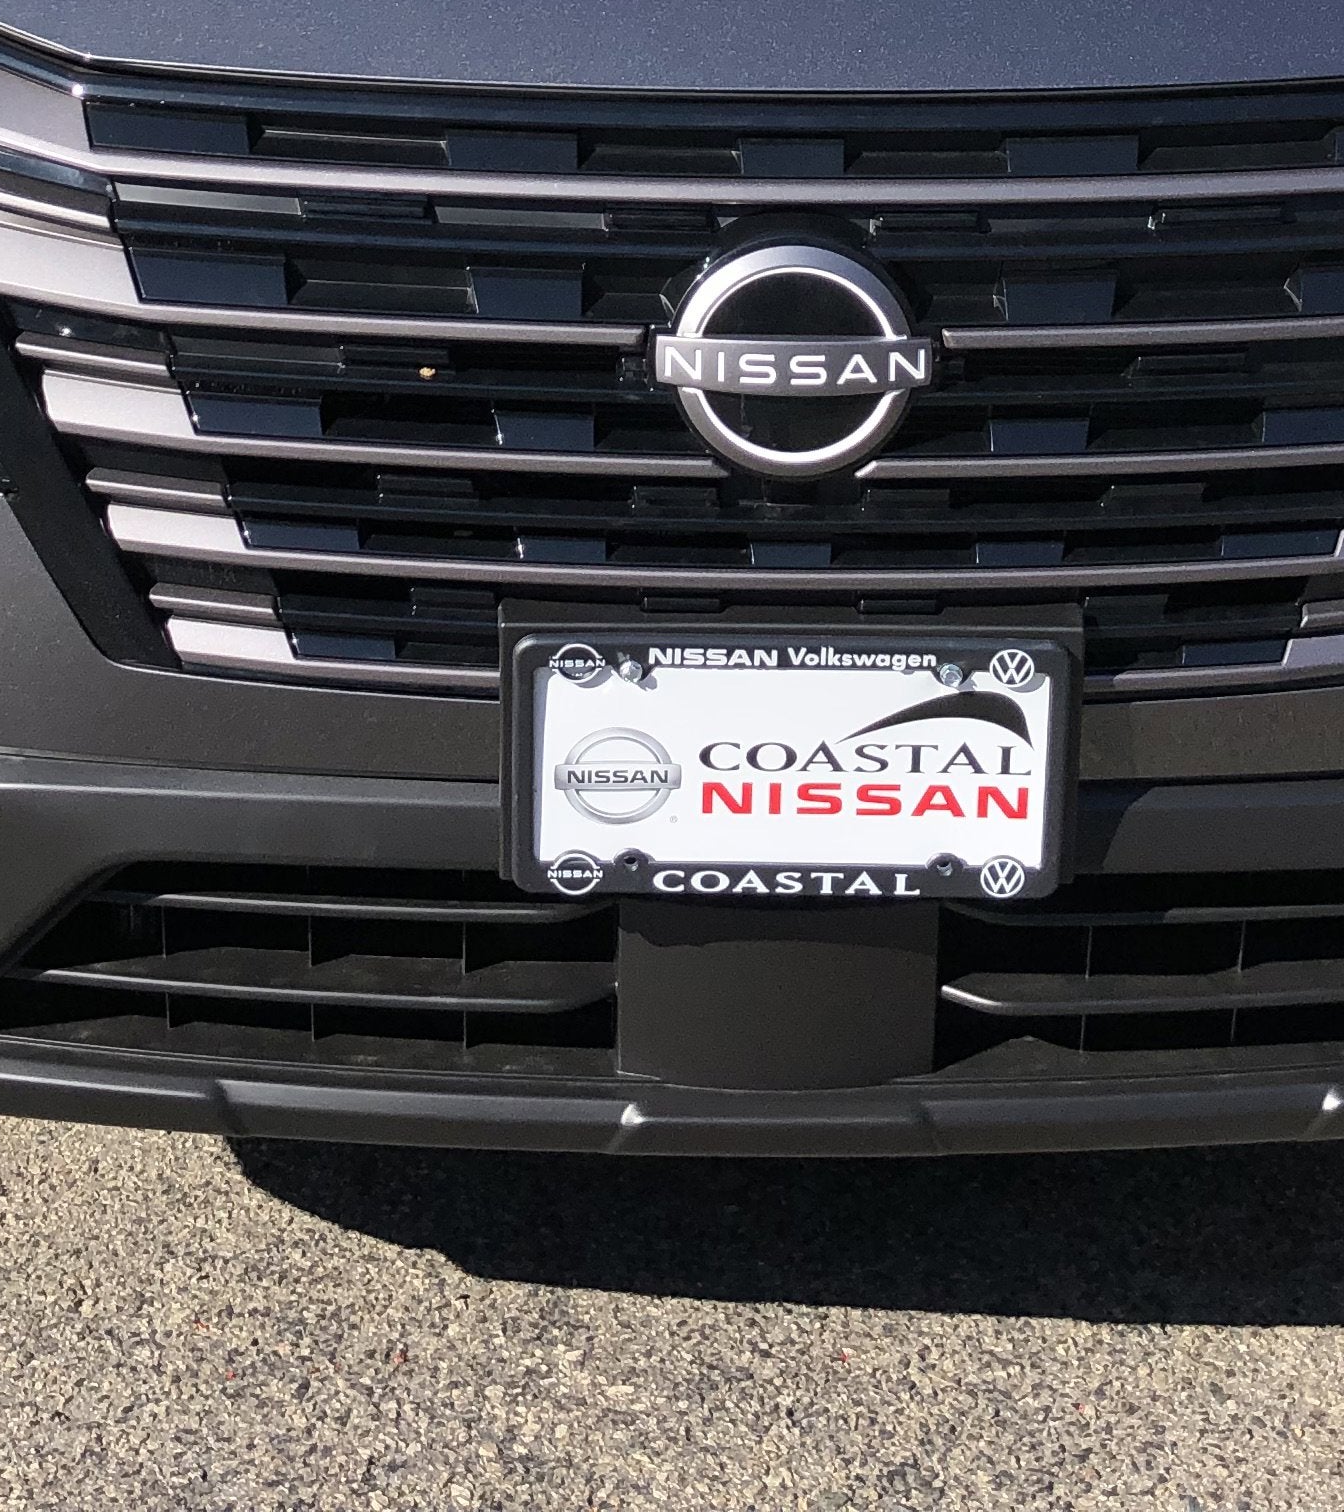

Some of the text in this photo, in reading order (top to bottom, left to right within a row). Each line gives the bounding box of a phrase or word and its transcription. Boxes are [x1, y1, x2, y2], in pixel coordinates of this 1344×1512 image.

[663, 346, 926, 386] NISSAN
[549, 656, 605, 670] NISSAN
[648, 647, 937, 668] NISSAN Volkswagen
[989, 649, 1035, 686] VW
[698, 740, 1033, 777] COASTAL
[567, 768, 669, 785] NISSAN
[701, 782, 1029, 819] NISSAN
[547, 868, 603, 881] NISSAN
[652, 870, 921, 896] COASTAL
[981, 858, 1025, 896] VW
